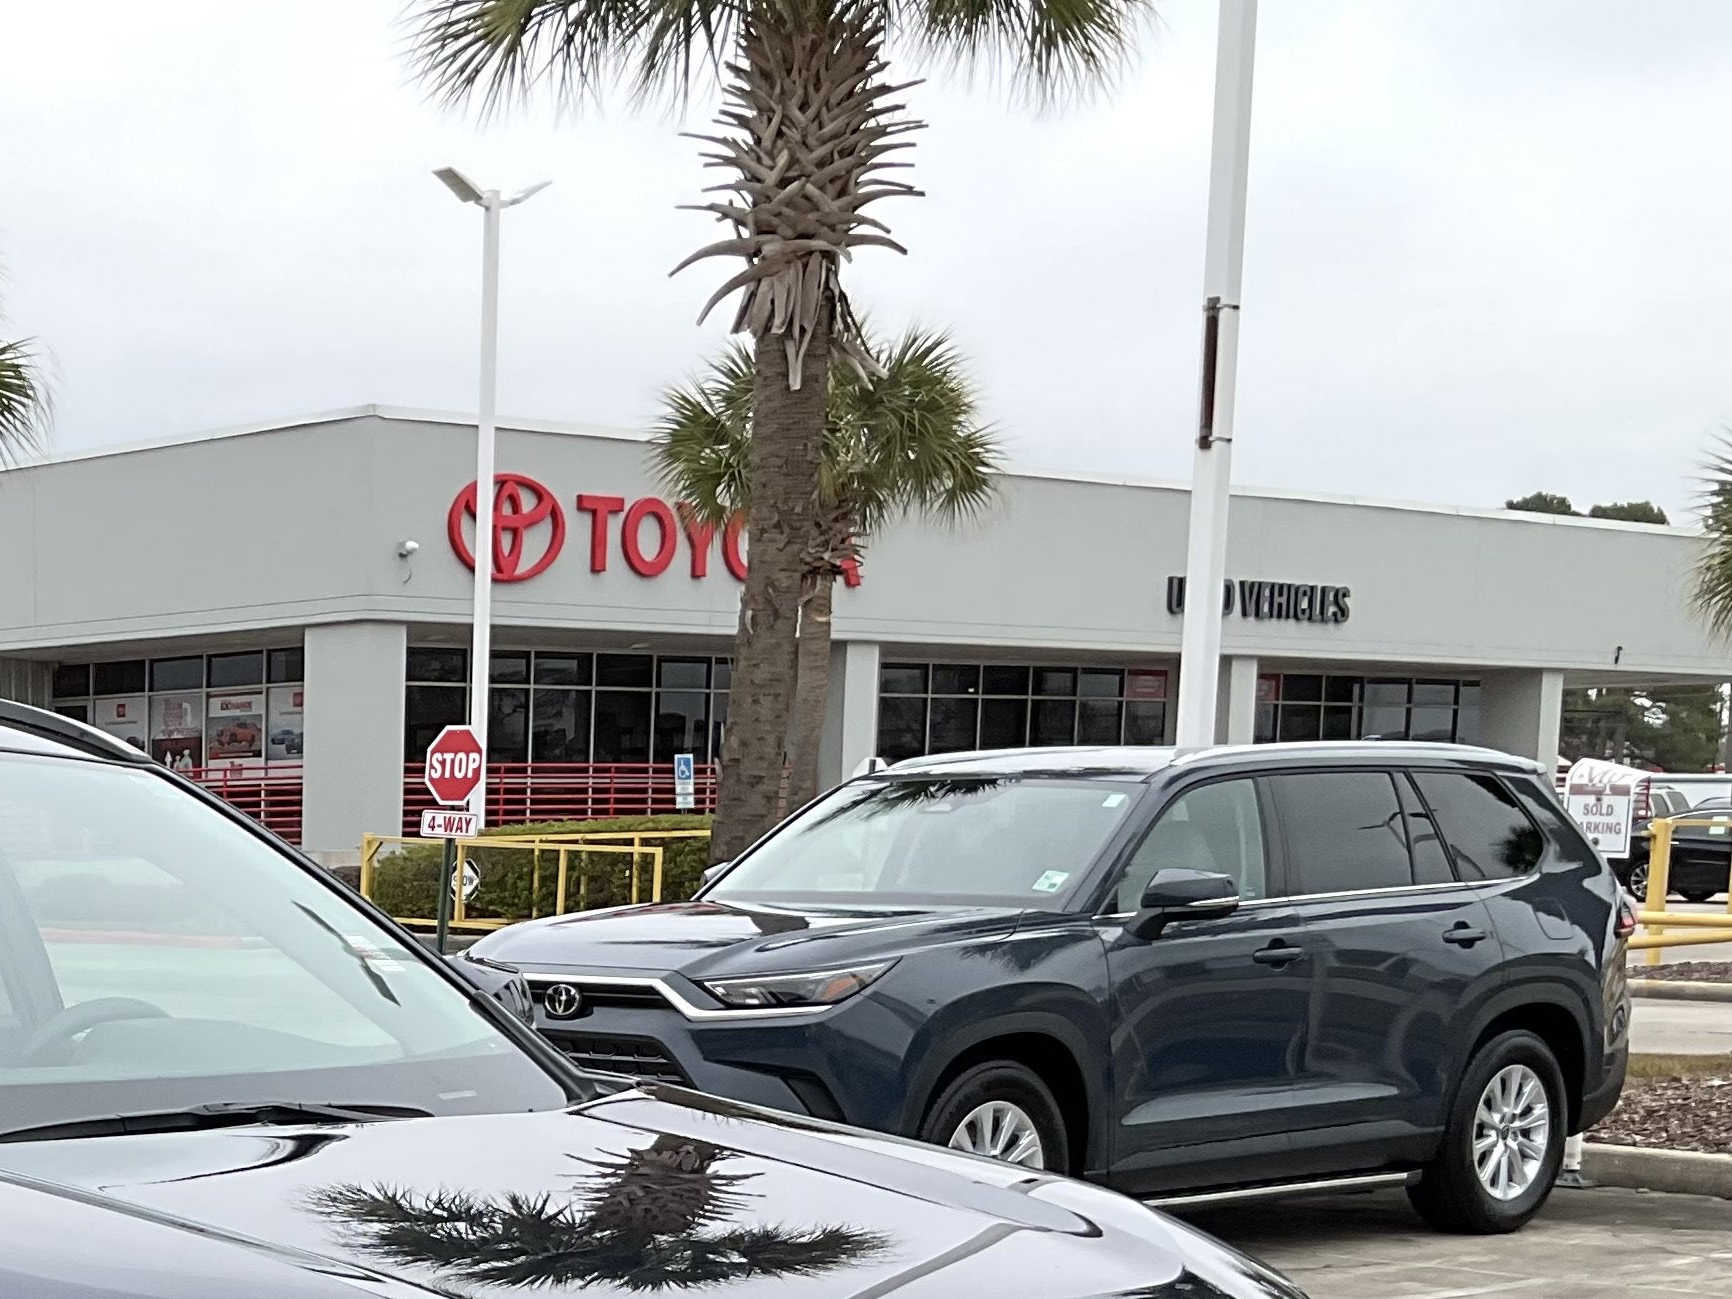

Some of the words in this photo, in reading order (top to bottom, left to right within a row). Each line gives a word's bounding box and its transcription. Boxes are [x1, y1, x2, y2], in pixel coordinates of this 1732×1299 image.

[576, 494, 861, 587] TOY
[1166, 576, 1235, 616] UD
[1239, 580, 1351, 624] VEHICLES
[430, 752, 481, 779] STOP
[1583, 803, 1614, 817] SOLD
[428, 815, 473, 834] 4-WAY
[1579, 821, 1622, 835] ARKING
[452, 875, 475, 887] SOW
